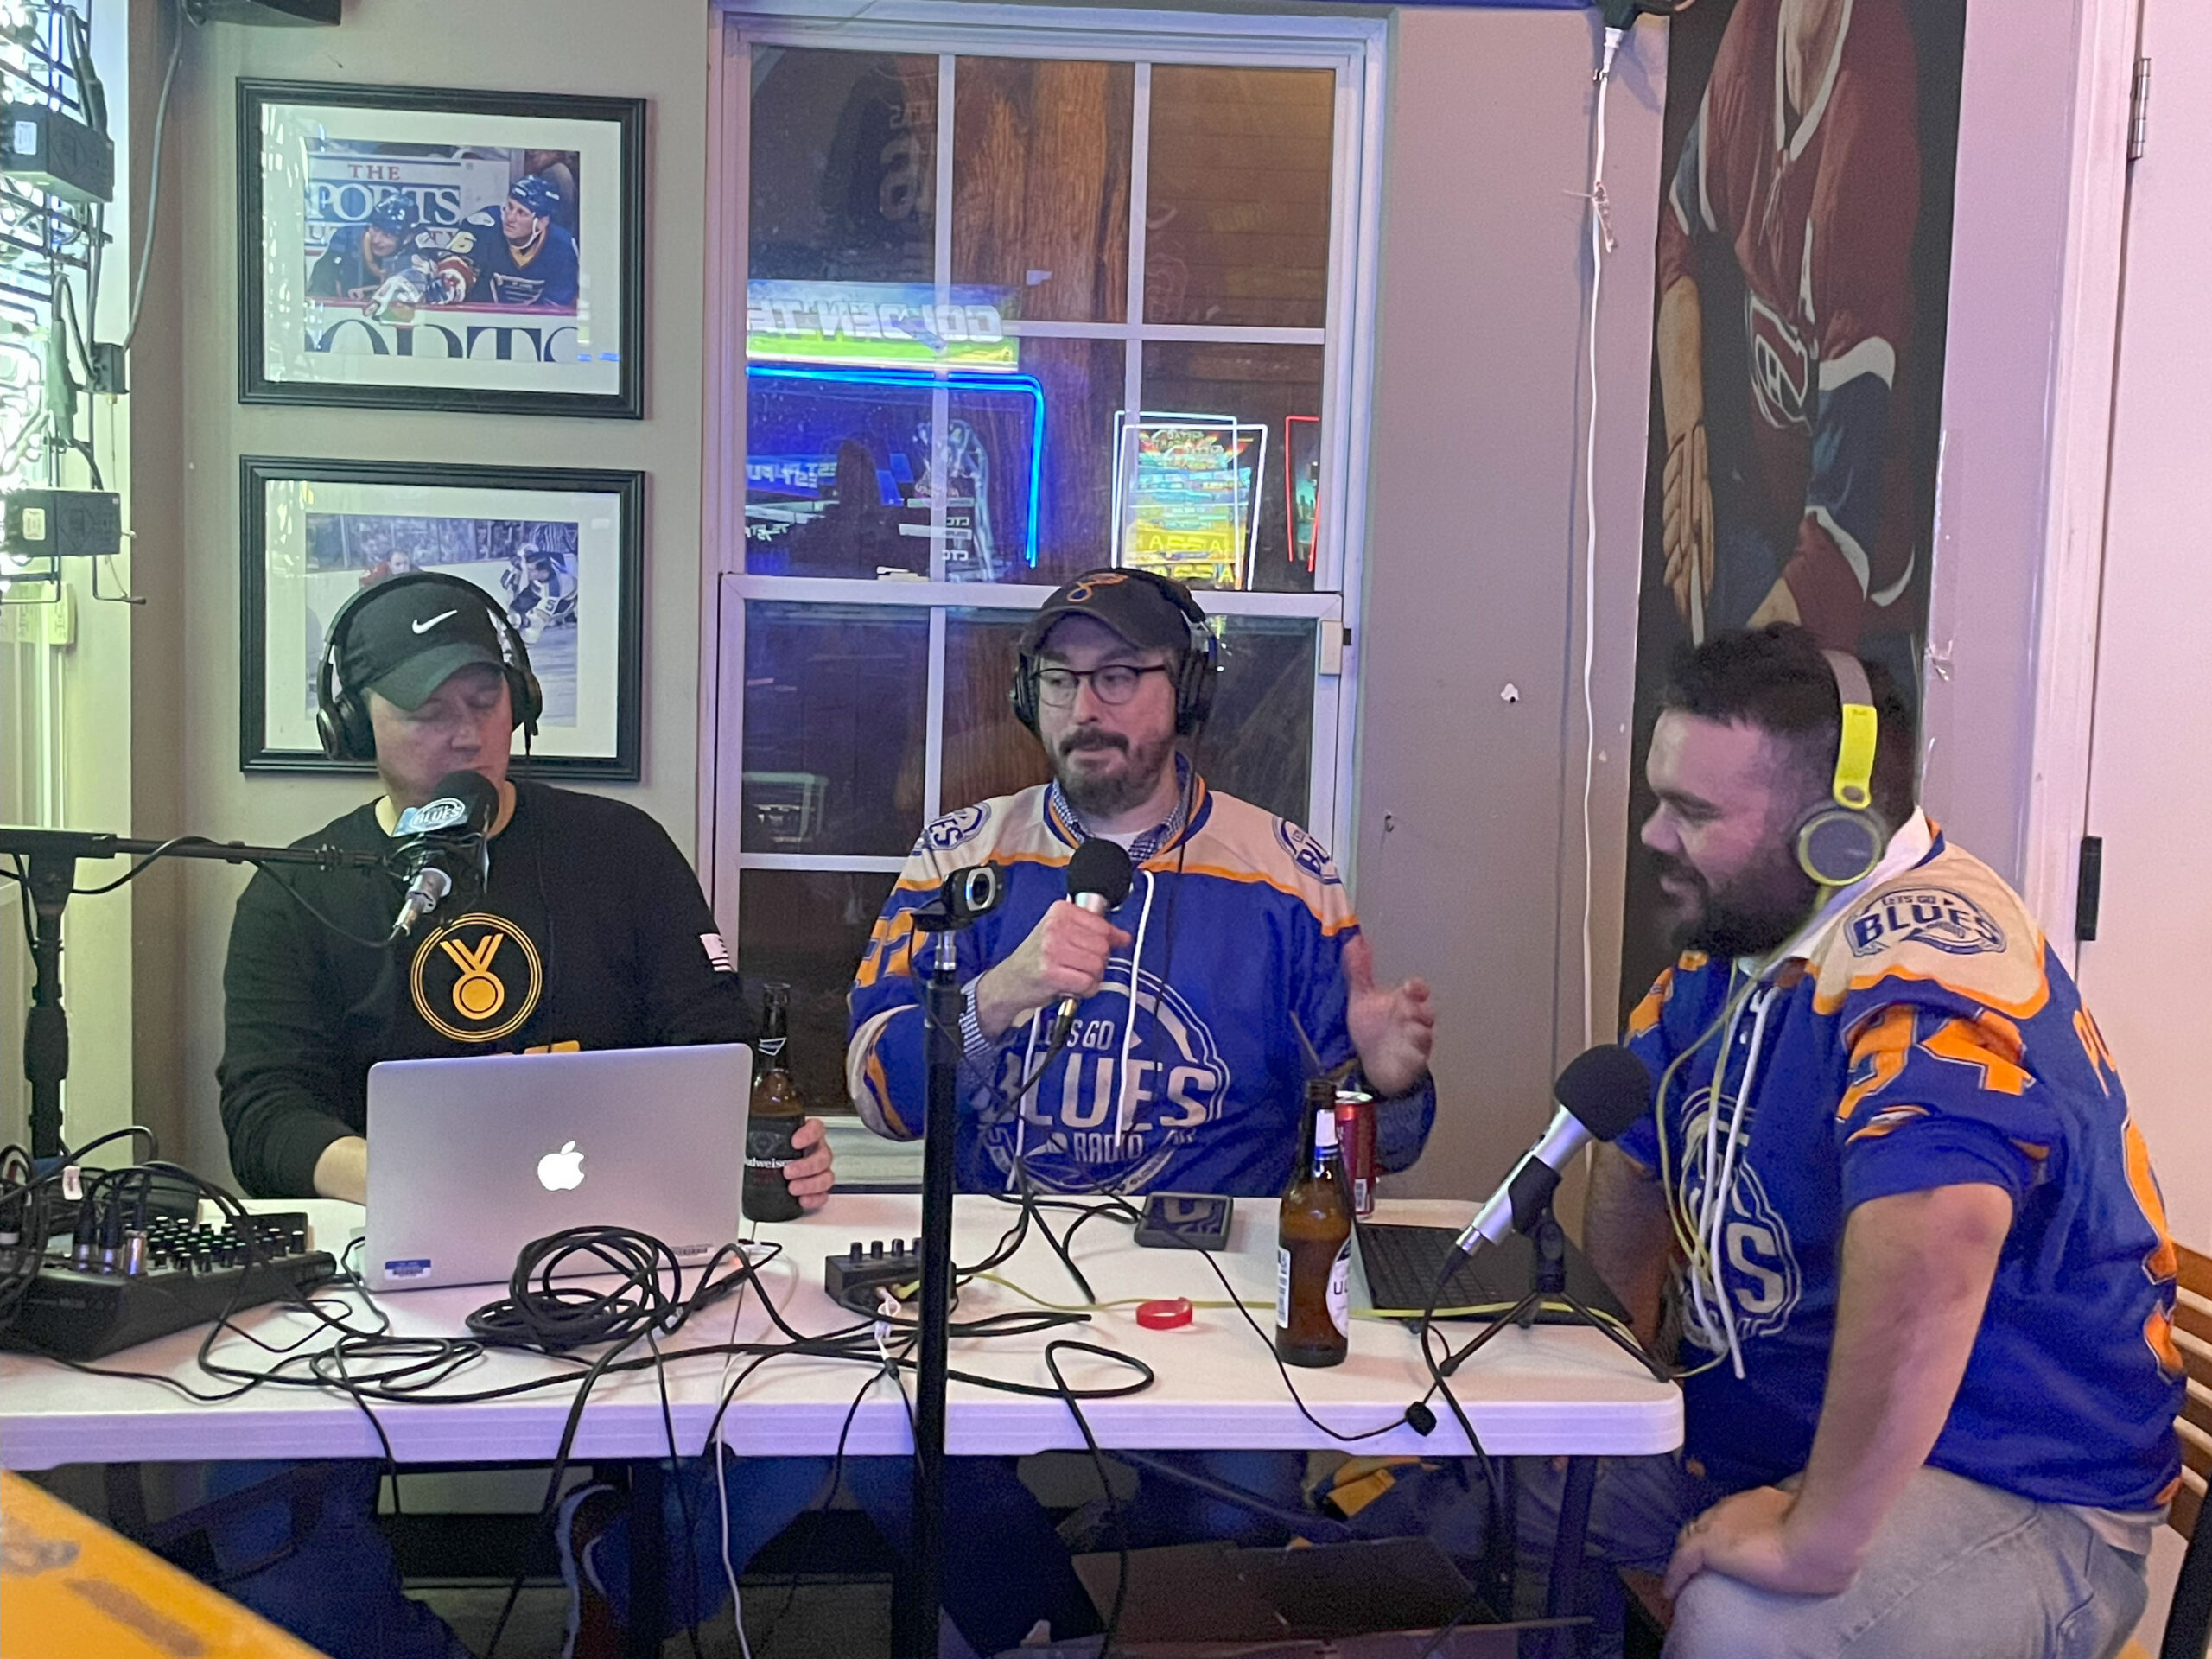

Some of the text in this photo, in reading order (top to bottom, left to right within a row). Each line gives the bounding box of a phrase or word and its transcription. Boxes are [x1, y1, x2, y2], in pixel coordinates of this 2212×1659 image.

[347, 164, 401, 181] THE
[305, 181, 461, 226] POTS
[413, 805, 461, 826] BLUES
[1853, 904, 1999, 949] BLUES
[1082, 1020, 1116, 1051] GO
